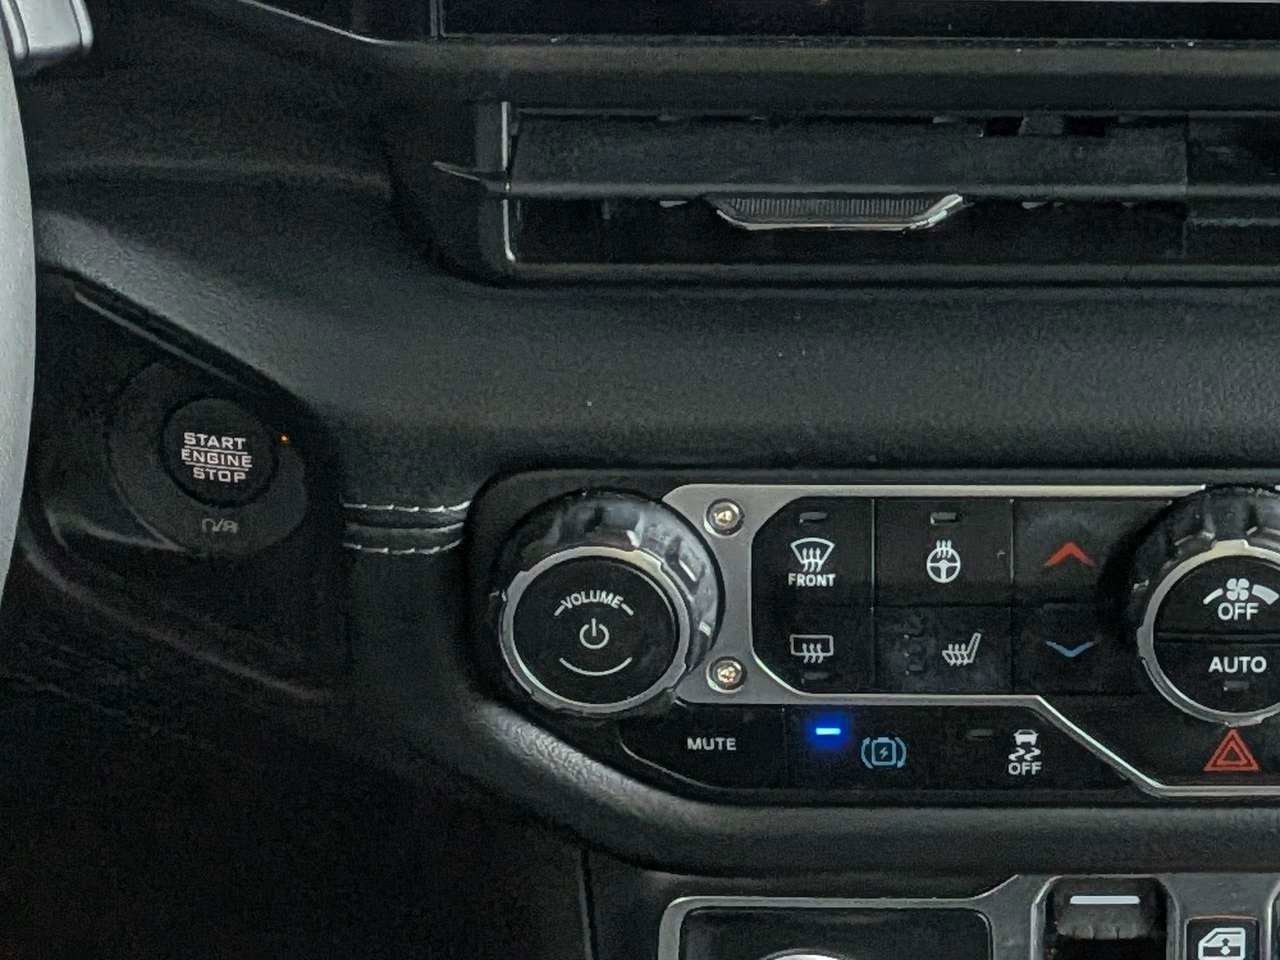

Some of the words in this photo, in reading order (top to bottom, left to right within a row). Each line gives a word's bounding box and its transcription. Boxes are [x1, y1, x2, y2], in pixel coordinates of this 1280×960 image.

[183, 432, 246, 450] START
[181, 448, 252, 468] ENGINE
[193, 466, 247, 483] STOP
[788, 573, 836, 587] FRONT
[562, 590, 624, 610] VOLUME
[1217, 602, 1259, 621] OFF
[1208, 656, 1267, 673] AUTO
[687, 737, 737, 752] MUTE
[1008, 761, 1042, 776] OFF
